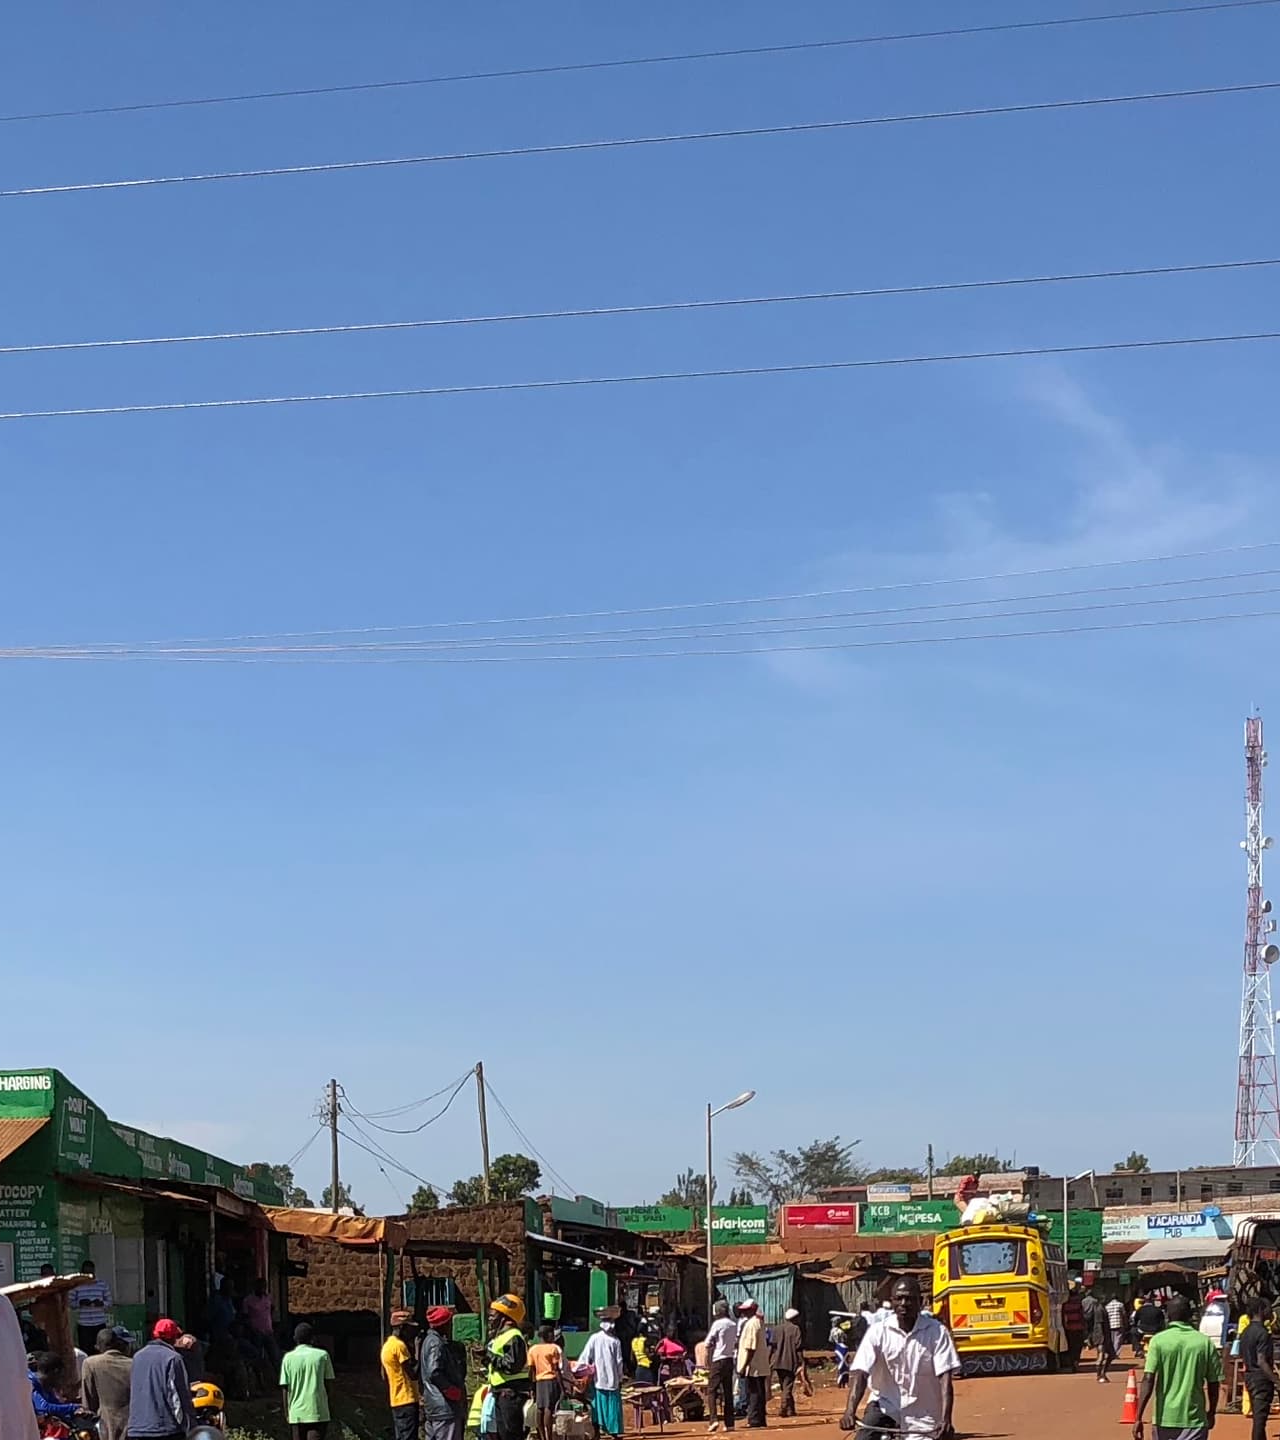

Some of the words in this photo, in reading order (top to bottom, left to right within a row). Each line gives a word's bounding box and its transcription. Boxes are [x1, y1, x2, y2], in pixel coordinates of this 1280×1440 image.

[871, 1205, 890, 1217] KCB
[704, 1217, 765, 1230] Safaricom
[1164, 1228, 1183, 1238] PUB
